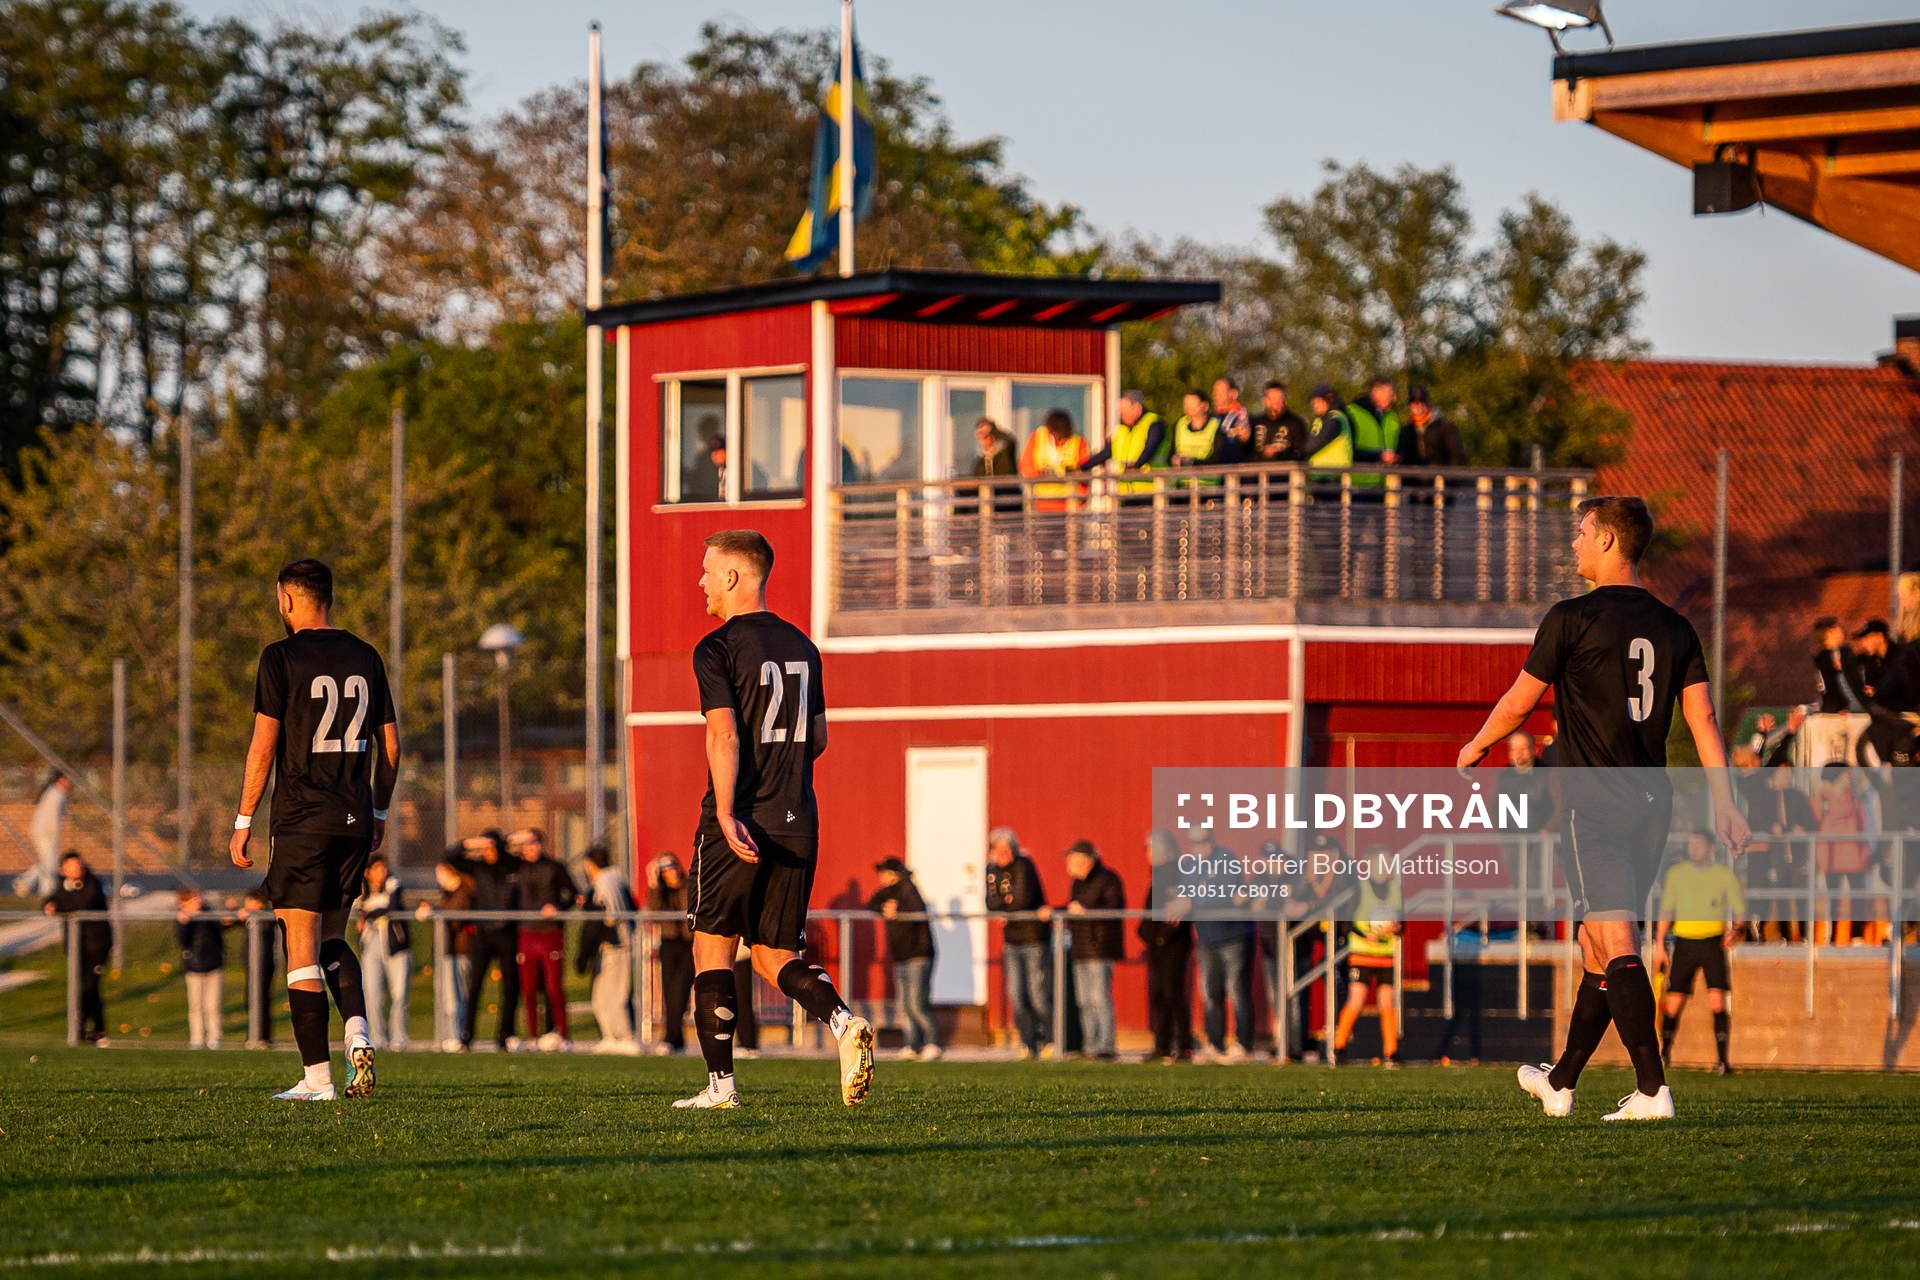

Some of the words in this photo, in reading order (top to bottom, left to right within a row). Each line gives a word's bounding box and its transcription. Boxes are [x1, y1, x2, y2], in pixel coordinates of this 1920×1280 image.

[311, 675, 369, 753] 22
[759, 660, 810, 744] 27
[1627, 637, 1656, 722] 3
